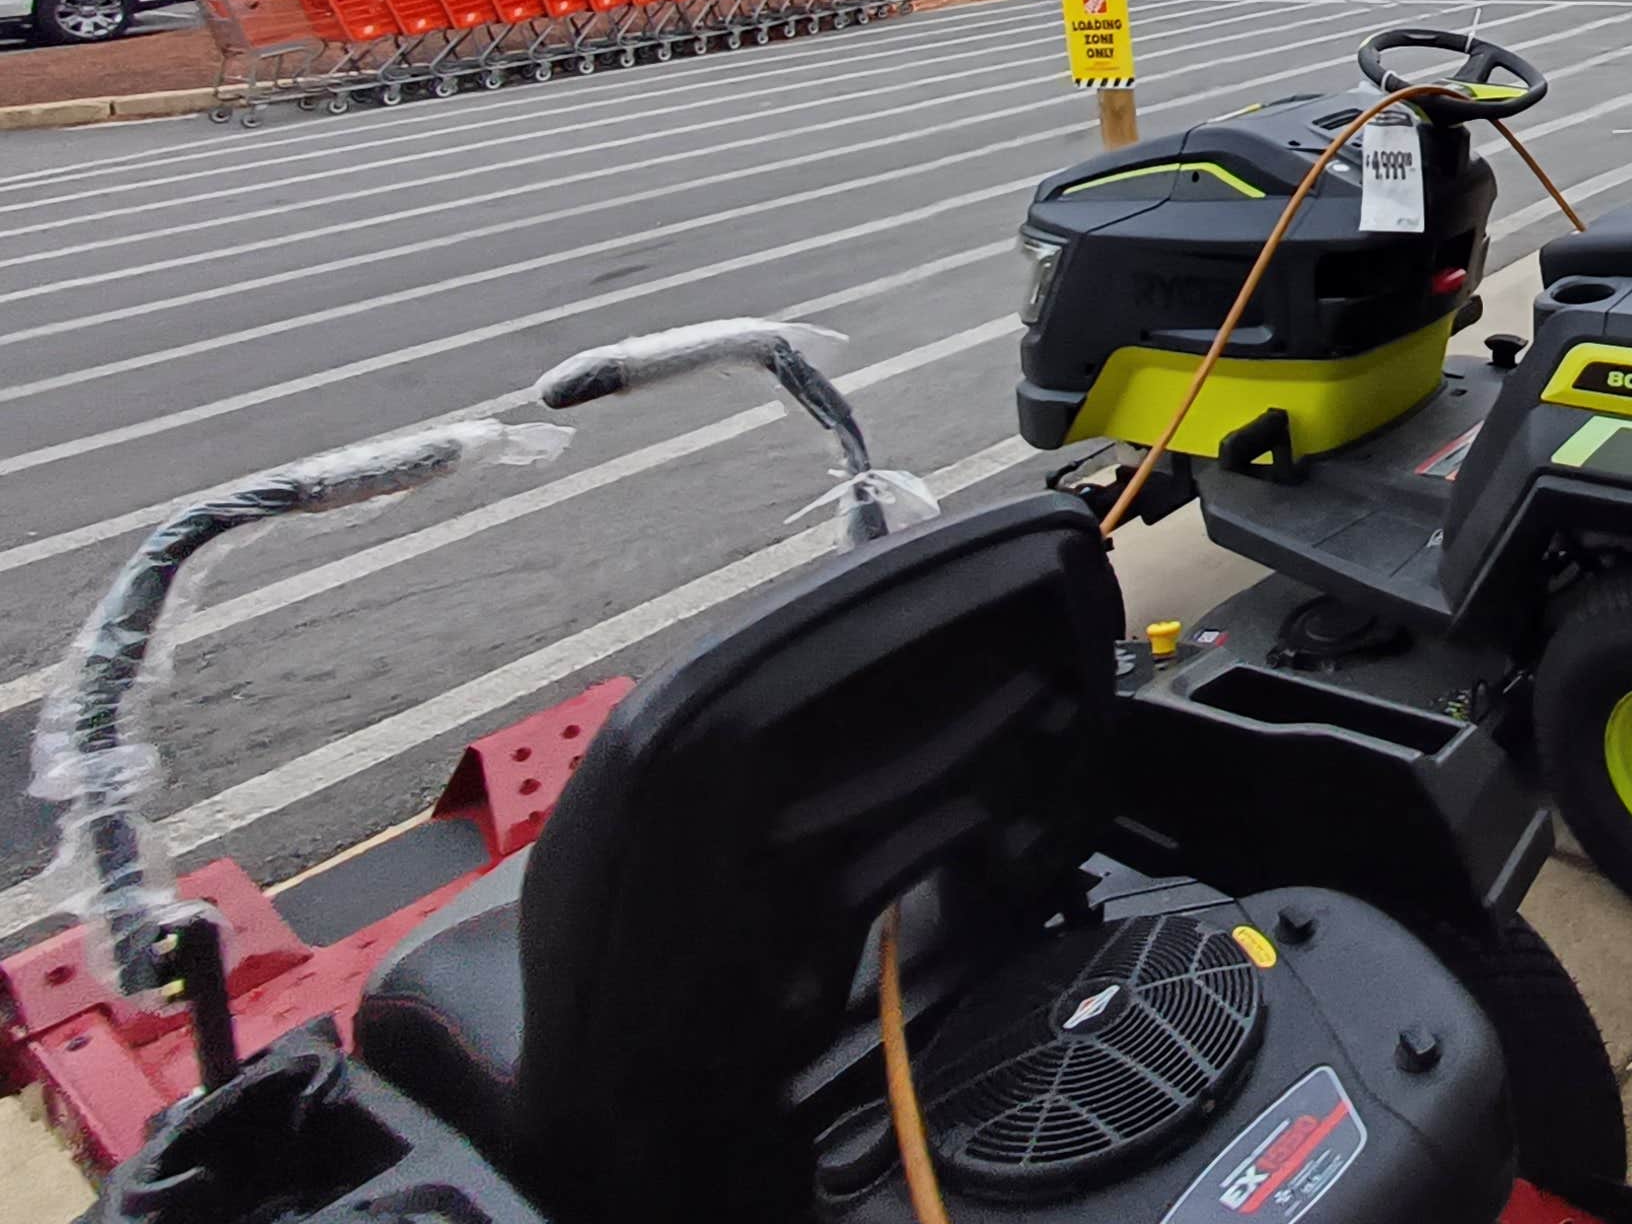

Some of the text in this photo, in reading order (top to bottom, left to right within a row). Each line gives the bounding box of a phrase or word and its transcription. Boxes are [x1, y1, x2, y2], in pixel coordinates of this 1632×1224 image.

[1072, 18, 1122, 32] LOADING
[1084, 33, 1114, 45] ZONE
[1086, 47, 1114, 58] ONLY
